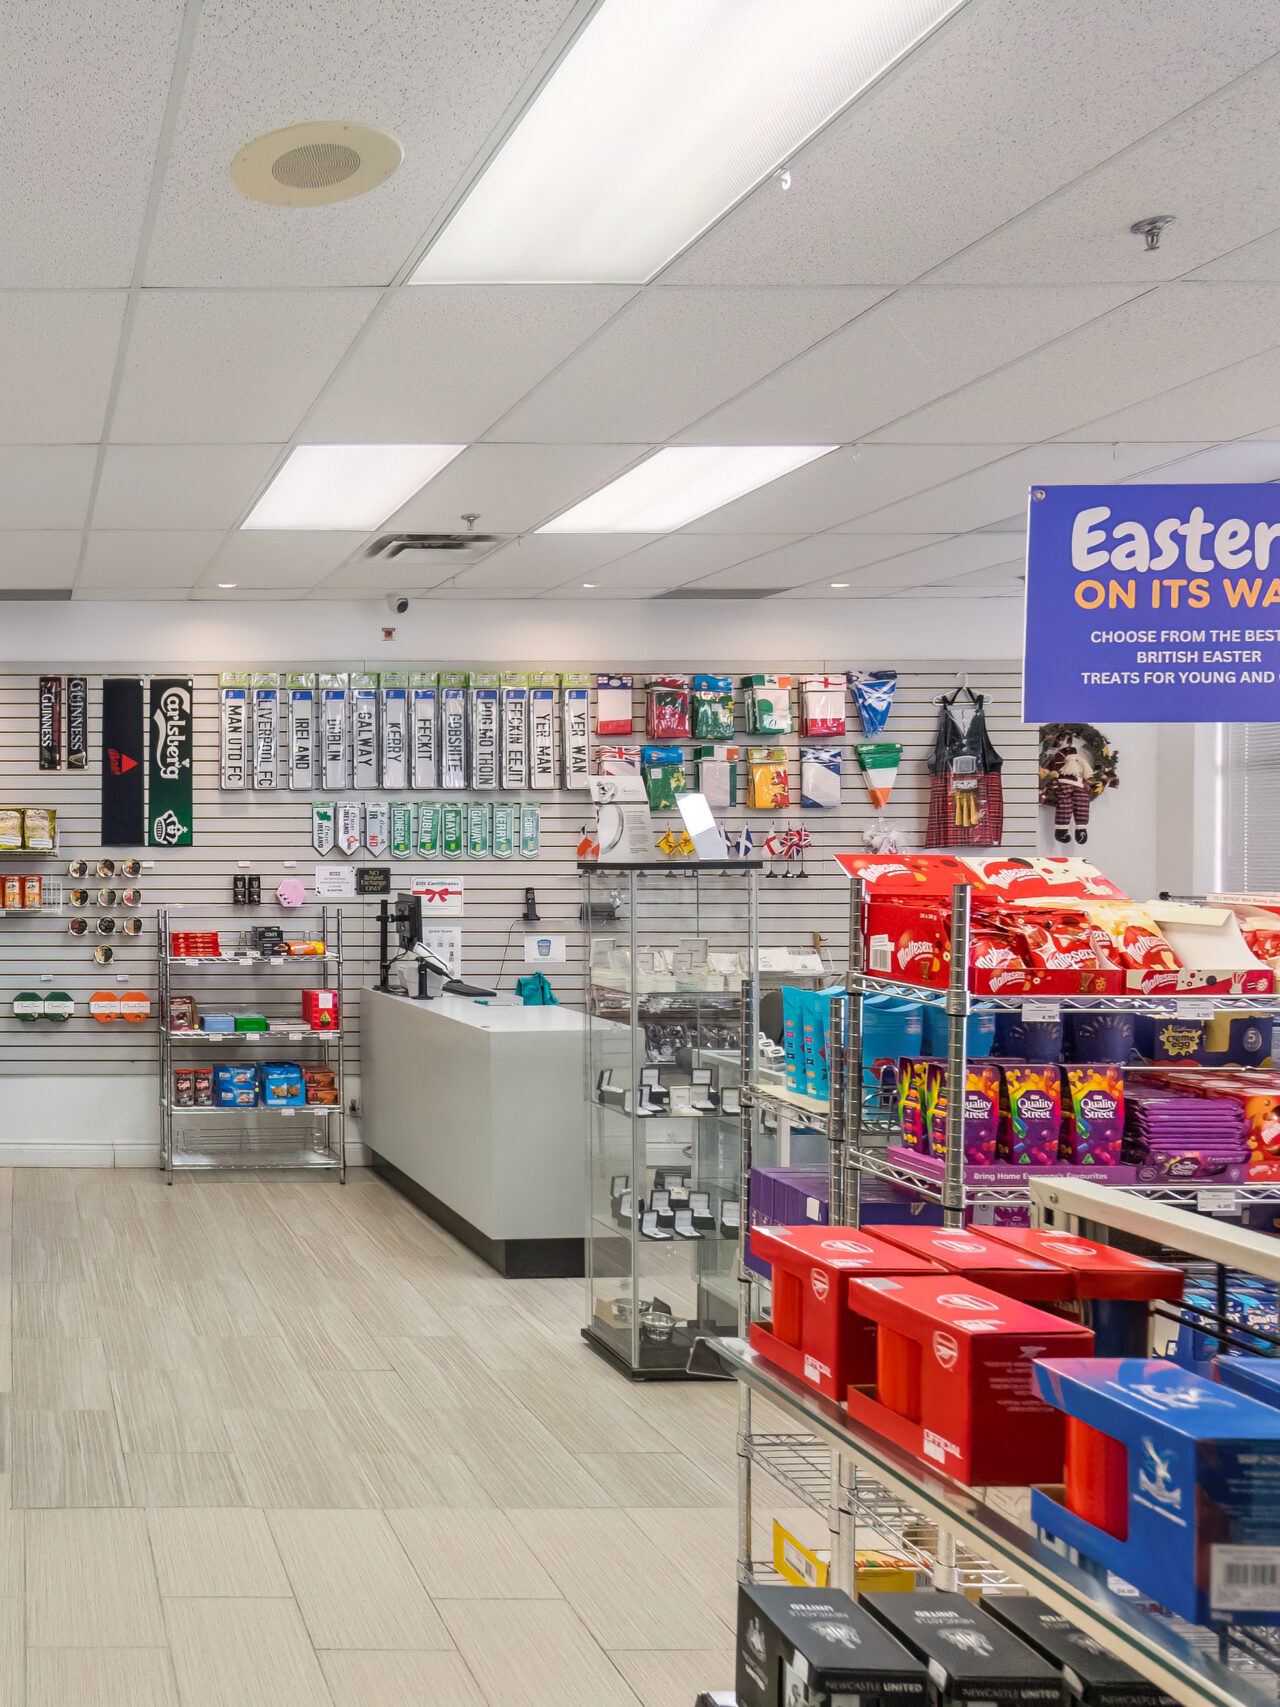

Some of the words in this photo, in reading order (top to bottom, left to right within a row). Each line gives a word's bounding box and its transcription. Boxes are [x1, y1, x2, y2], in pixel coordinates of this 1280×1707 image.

[1071, 505, 1280, 573] Easter
[1074, 579, 1136, 609] ON
[1151, 578, 1211, 609] ITS
[1090, 630, 1157, 643] CHOOSE
[1160, 630, 1206, 643] FROM
[1209, 629, 1241, 643] THE
[1244, 629, 1280, 642] BEST
[1136, 650, 1199, 664] BRITISH
[1202, 650, 1262, 663] EASTER
[1080, 671, 1140, 685] TREATS
[1143, 671, 1176, 685] FOR
[1178, 671, 1237, 684] YOUNG
[1239, 671, 1276, 684] AND
[41, 693, 56, 747] GUINNESS
[70, 679, 87, 751] GUINNESS
[227, 705, 243, 733] MAN
[535, 713, 551, 738] YER
[571, 712, 586, 737] YER
[152, 686, 192, 780] Carlsberg
[257, 700, 273, 768] LIVERPOOL
[295, 718, 310, 770] IRELAND
[357, 712, 373, 767] GALWAY
[387, 722, 402, 763] KERRY
[227, 737, 243, 761] UTD
[536, 745, 552, 774] MAN
[572, 745, 587, 774] WAN
[227, 765, 243, 781] FC
[258, 770, 273, 786] FC
[508, 751, 523, 783] EEJIT
[393, 809, 406, 846] DONEGAL
[421, 808, 434, 845] DUBLIN
[444, 811, 456, 842] MAYO
[471, 809, 482, 845] GALWAY
[495, 810, 507, 845] KERRY
[525, 816, 534, 838] CORK
[857, 863, 908, 883] Maltesers
[988, 867, 1039, 890] Maltesers
[896, 941, 934, 971] Maltesers
[988, 971, 1026, 993] Maltesers
[1141, 971, 1179, 995] Maltesers
[1166, 1034, 1196, 1043] creme
[1171, 1041, 1191, 1051] egg
[1247, 1029, 1256, 1041] 5
[965, 1098, 992, 1113] uality
[1017, 1097, 1054, 1112] Quality
[1021, 1109, 1052, 1120] Street
[1080, 1097, 1118, 1112] Quality
[1084, 1109, 1115, 1120] Street
[973, 1172, 995, 1182] Bring
[997, 1172, 1020, 1181] Home
[824, 1679, 881, 1692] NEWCASTLE
[882, 1682, 923, 1693] UNITED
[962, 1687, 1020, 1699] NEWCASTLE
[1020, 1688, 1060, 1699] UNITED
